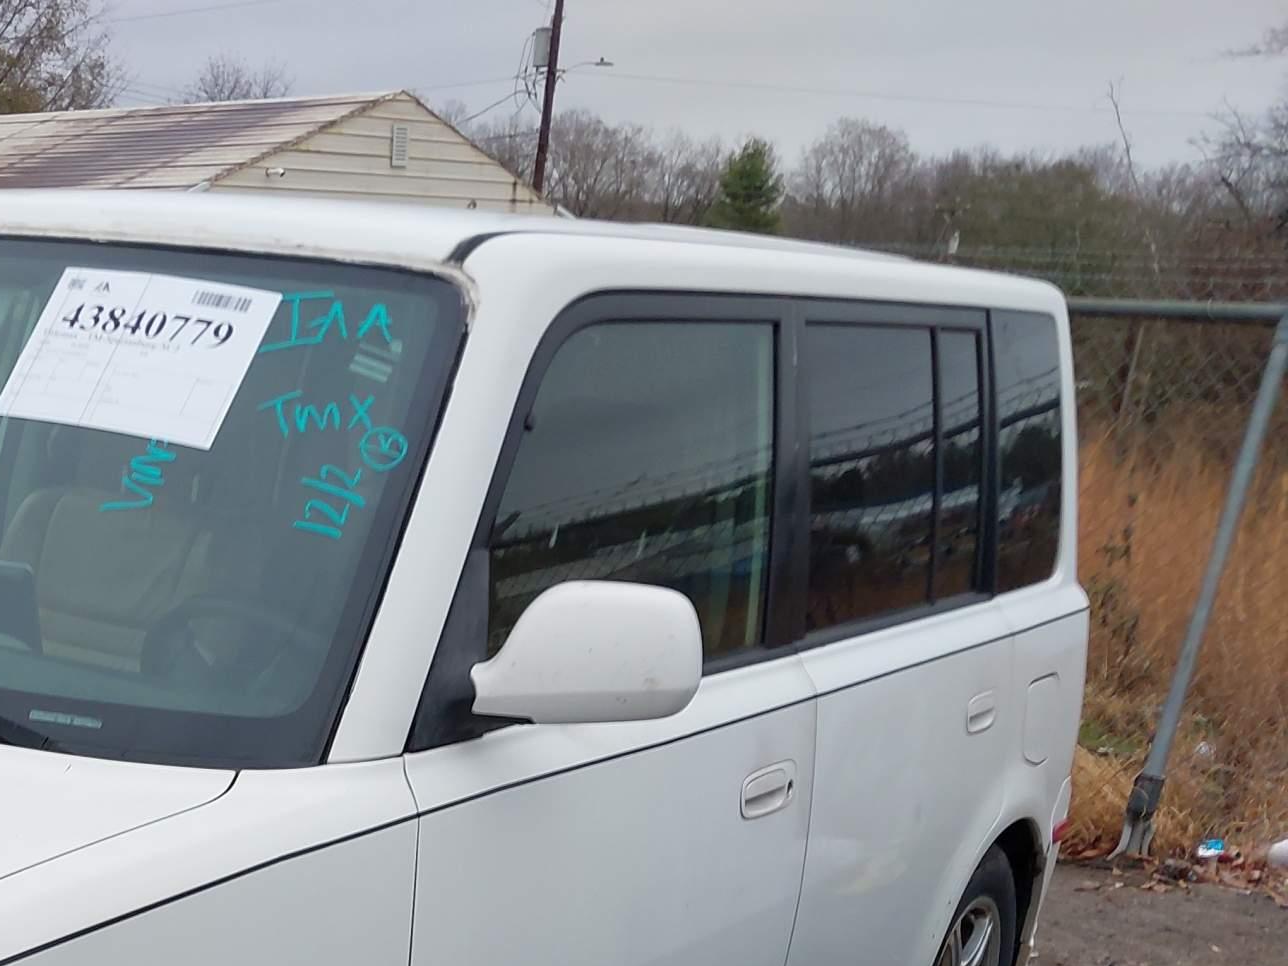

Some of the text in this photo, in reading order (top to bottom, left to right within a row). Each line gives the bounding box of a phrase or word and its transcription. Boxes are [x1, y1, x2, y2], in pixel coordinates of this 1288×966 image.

[61, 302, 234, 348] 43840779
[258, 290, 393, 352] IAA
[292, 463, 366, 539] 12/2
